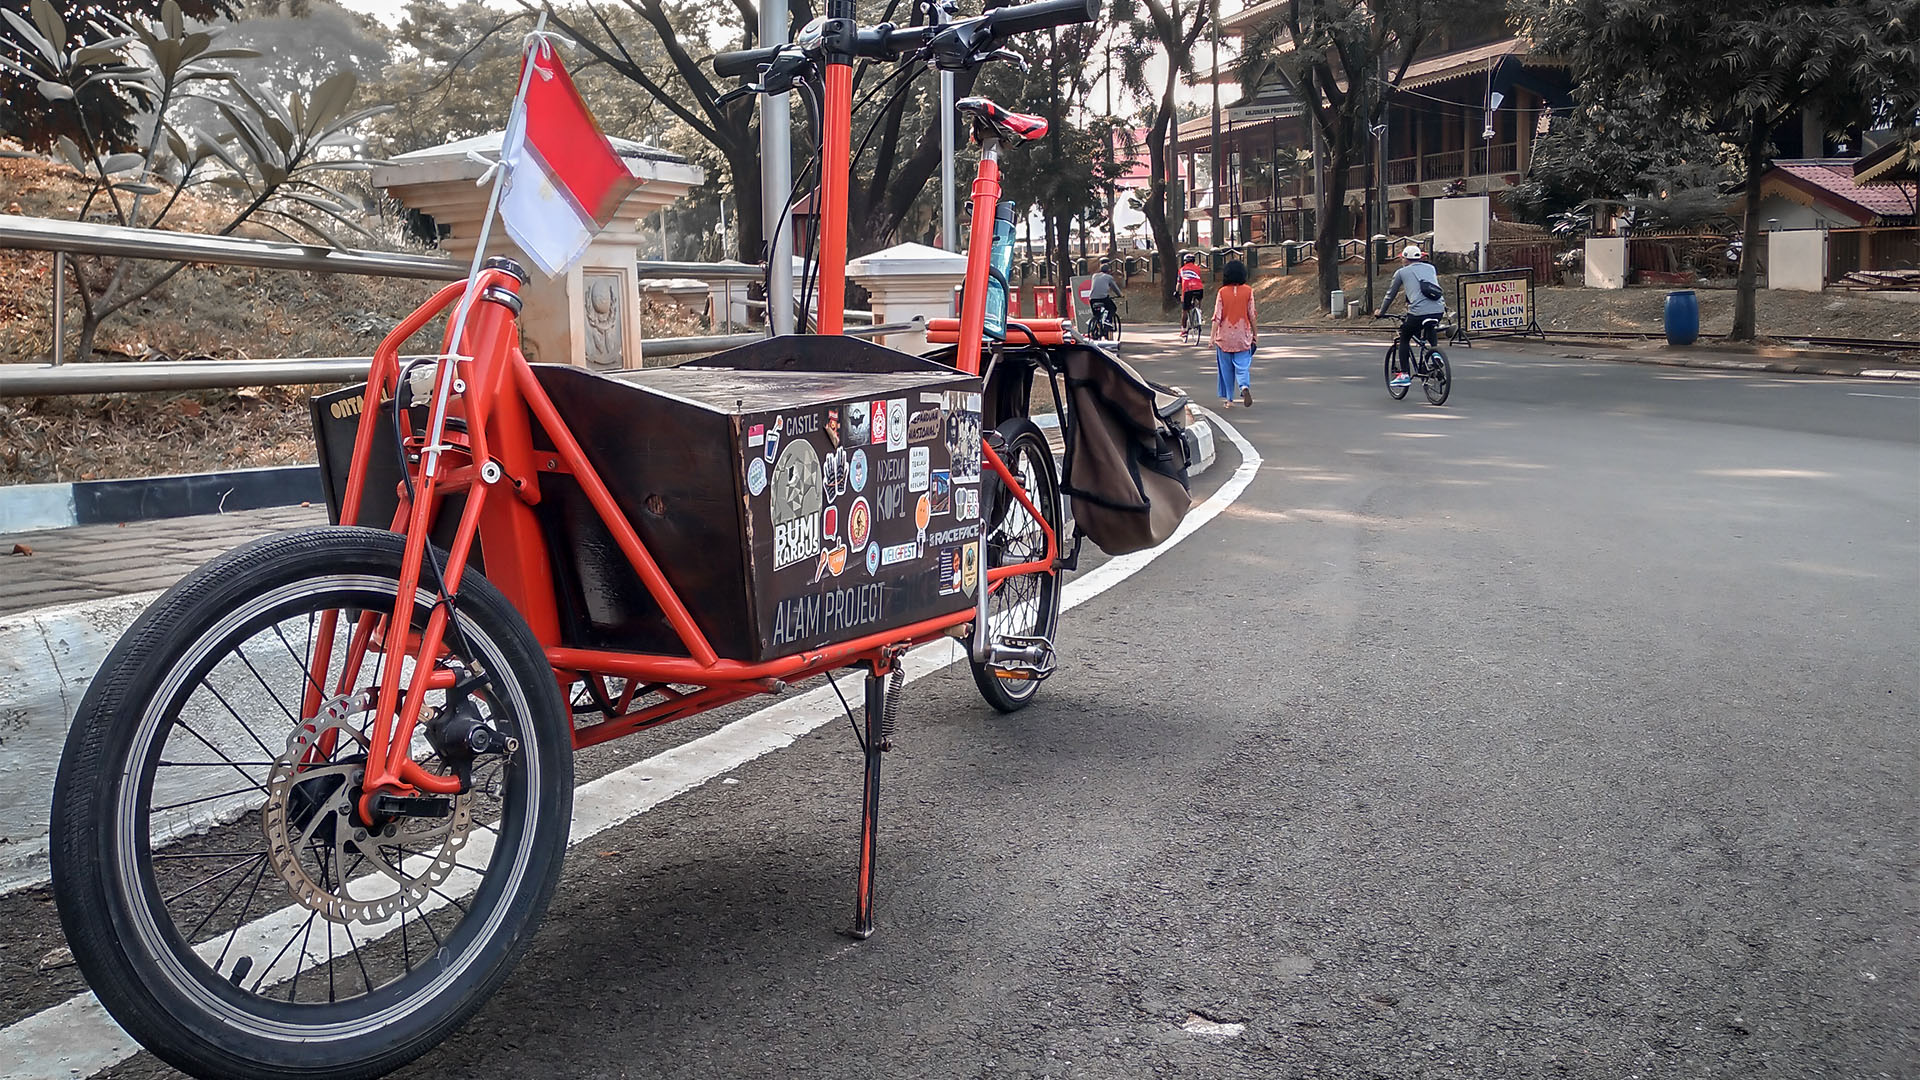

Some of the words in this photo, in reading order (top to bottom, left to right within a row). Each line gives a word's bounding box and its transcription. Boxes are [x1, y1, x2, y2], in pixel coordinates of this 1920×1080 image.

[1470, 296, 1493, 308] HATI
[1501, 294, 1524, 305] HATI
[1471, 308, 1499, 318] JALAN
[1501, 306, 1524, 315] LICIN
[1470, 320, 1488, 329] REL
[1490, 317, 1524, 327] KERETA
[786, 413, 819, 436] CASTLE
[876, 483, 906, 522] KOPI
[775, 512, 819, 551] BUMI
[775, 538, 819, 567] KARDUS
[773, 594, 820, 646] ALAM
[824, 581, 885, 633] PROJECT
